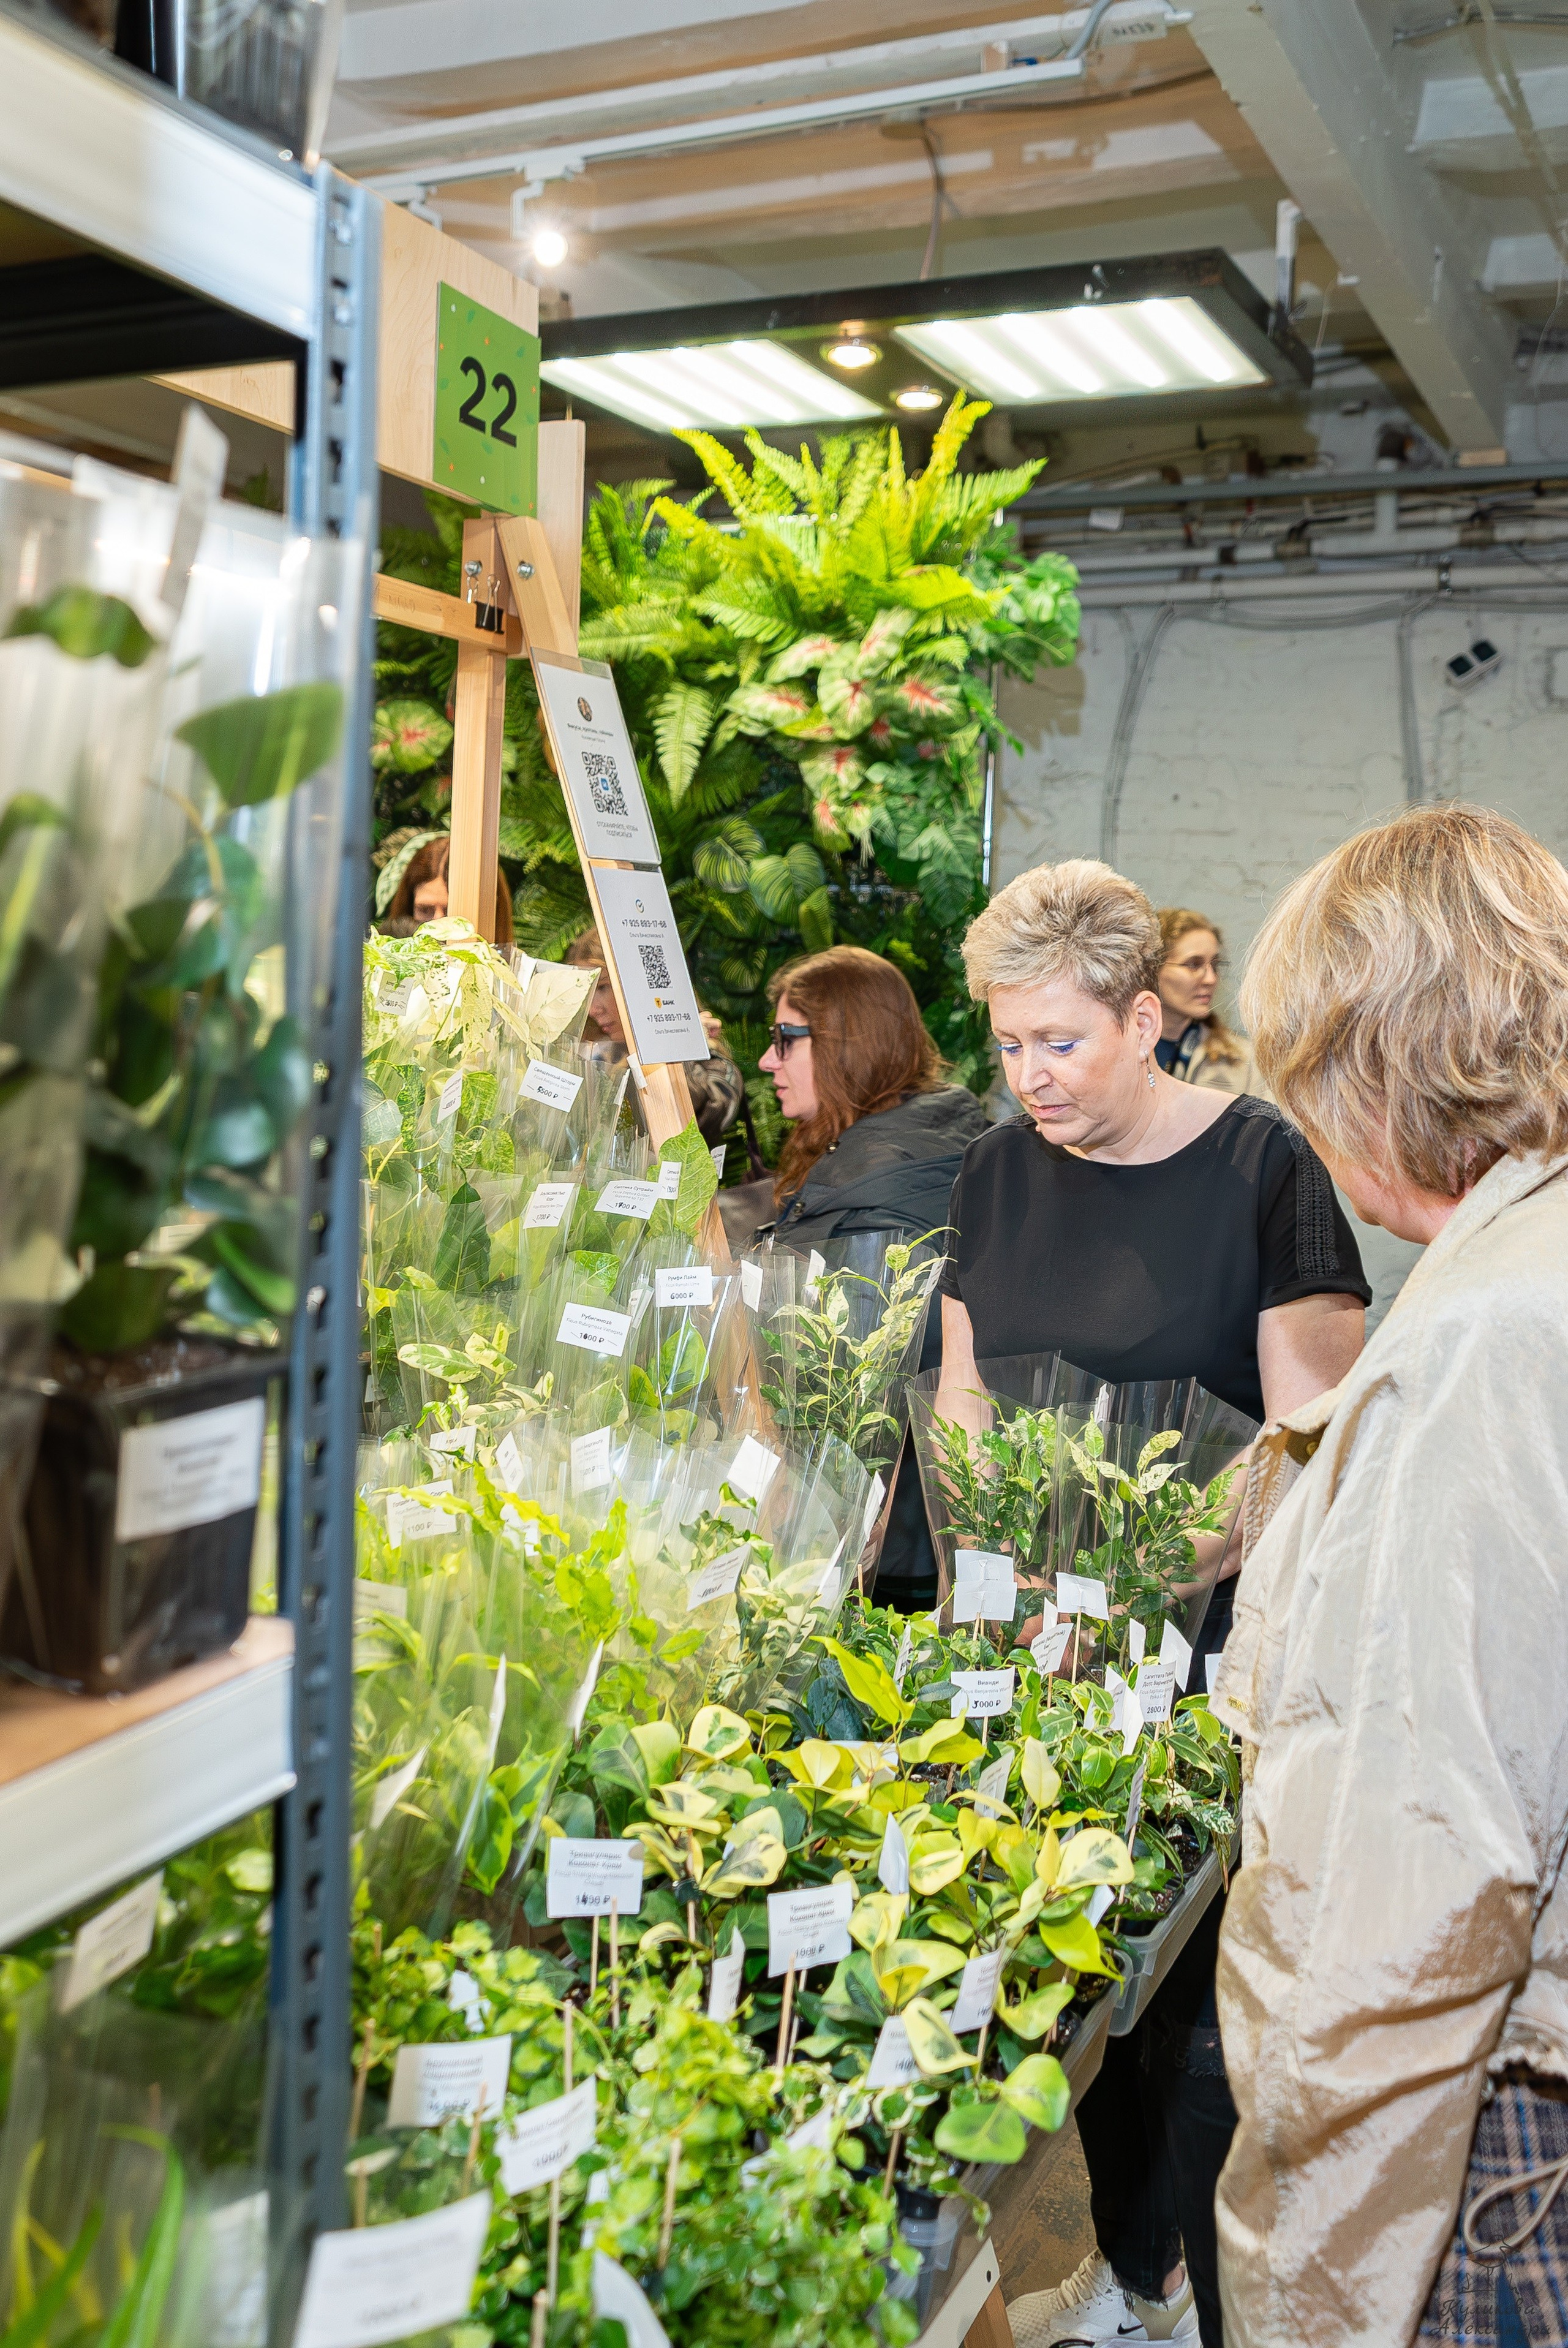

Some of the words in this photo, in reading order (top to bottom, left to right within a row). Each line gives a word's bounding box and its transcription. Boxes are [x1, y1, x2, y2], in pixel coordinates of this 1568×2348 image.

[459, 356, 518, 448] 22
[560, 1078, 576, 1086] Шторм
[537, 1085, 552, 1097] 5500
[581, 1313, 612, 1326] Рубигиноза
